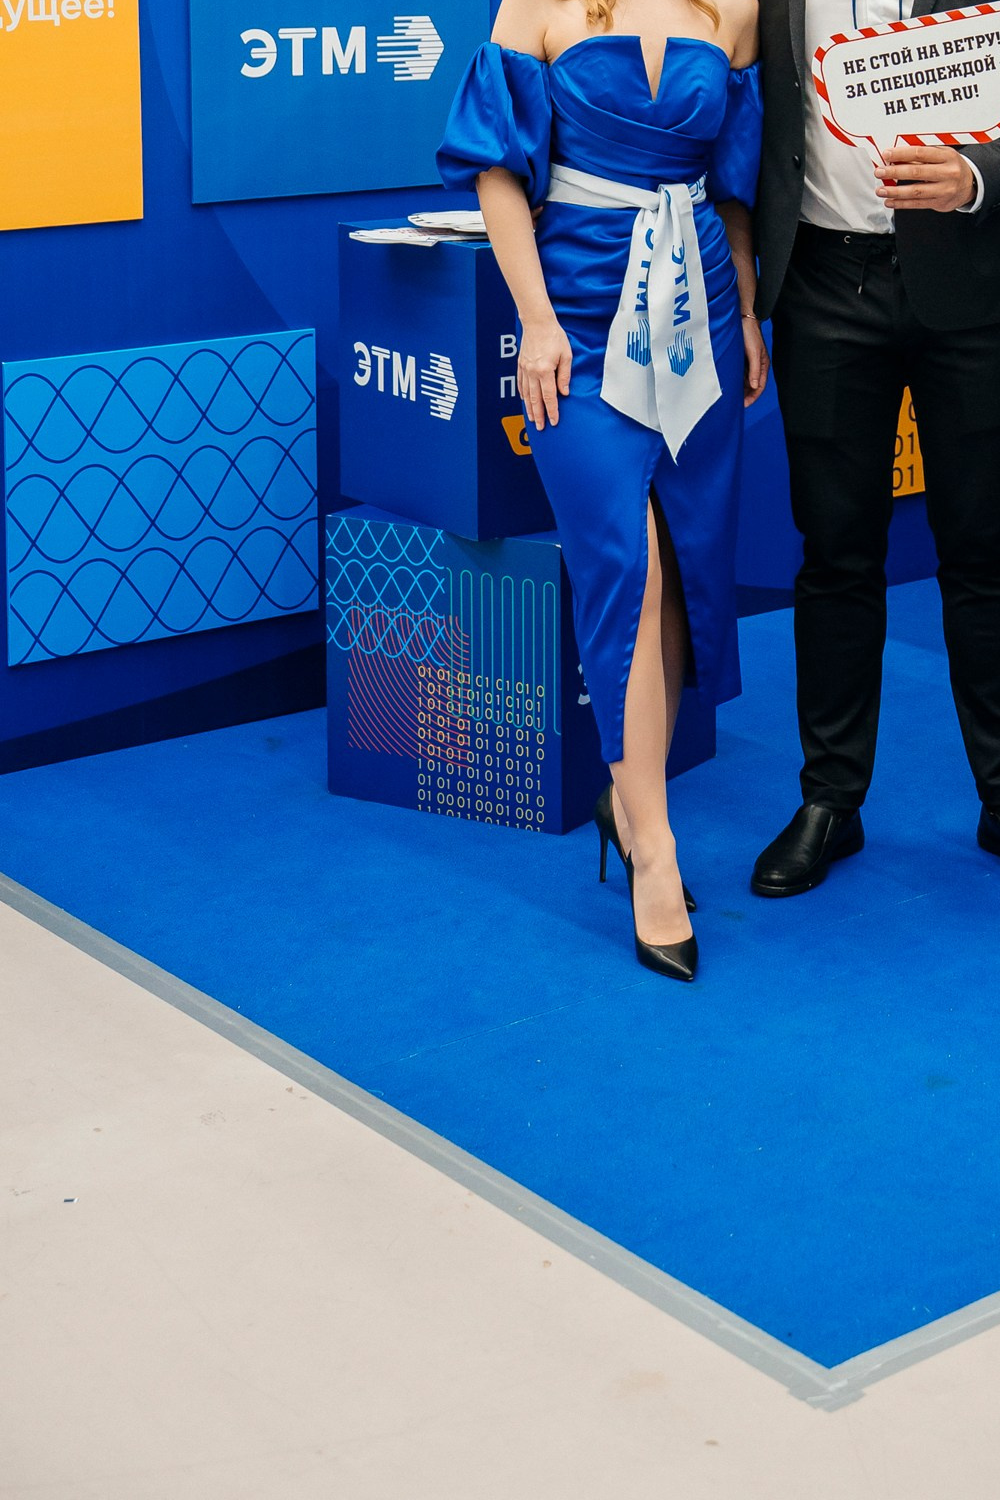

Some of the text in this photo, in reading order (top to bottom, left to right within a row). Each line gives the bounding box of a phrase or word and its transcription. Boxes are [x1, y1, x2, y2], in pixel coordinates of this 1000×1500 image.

[240, 26, 366, 78] ЭТМ
[843, 31, 1000, 75] НЕ СТОЙ НА ВЕТРУ!
[845, 82, 868, 99] ЗА
[870, 54, 997, 95] СПЕЦОДЕЖДОЙ
[883, 99, 908, 116] НА
[353, 341, 416, 402] ЭТМ
